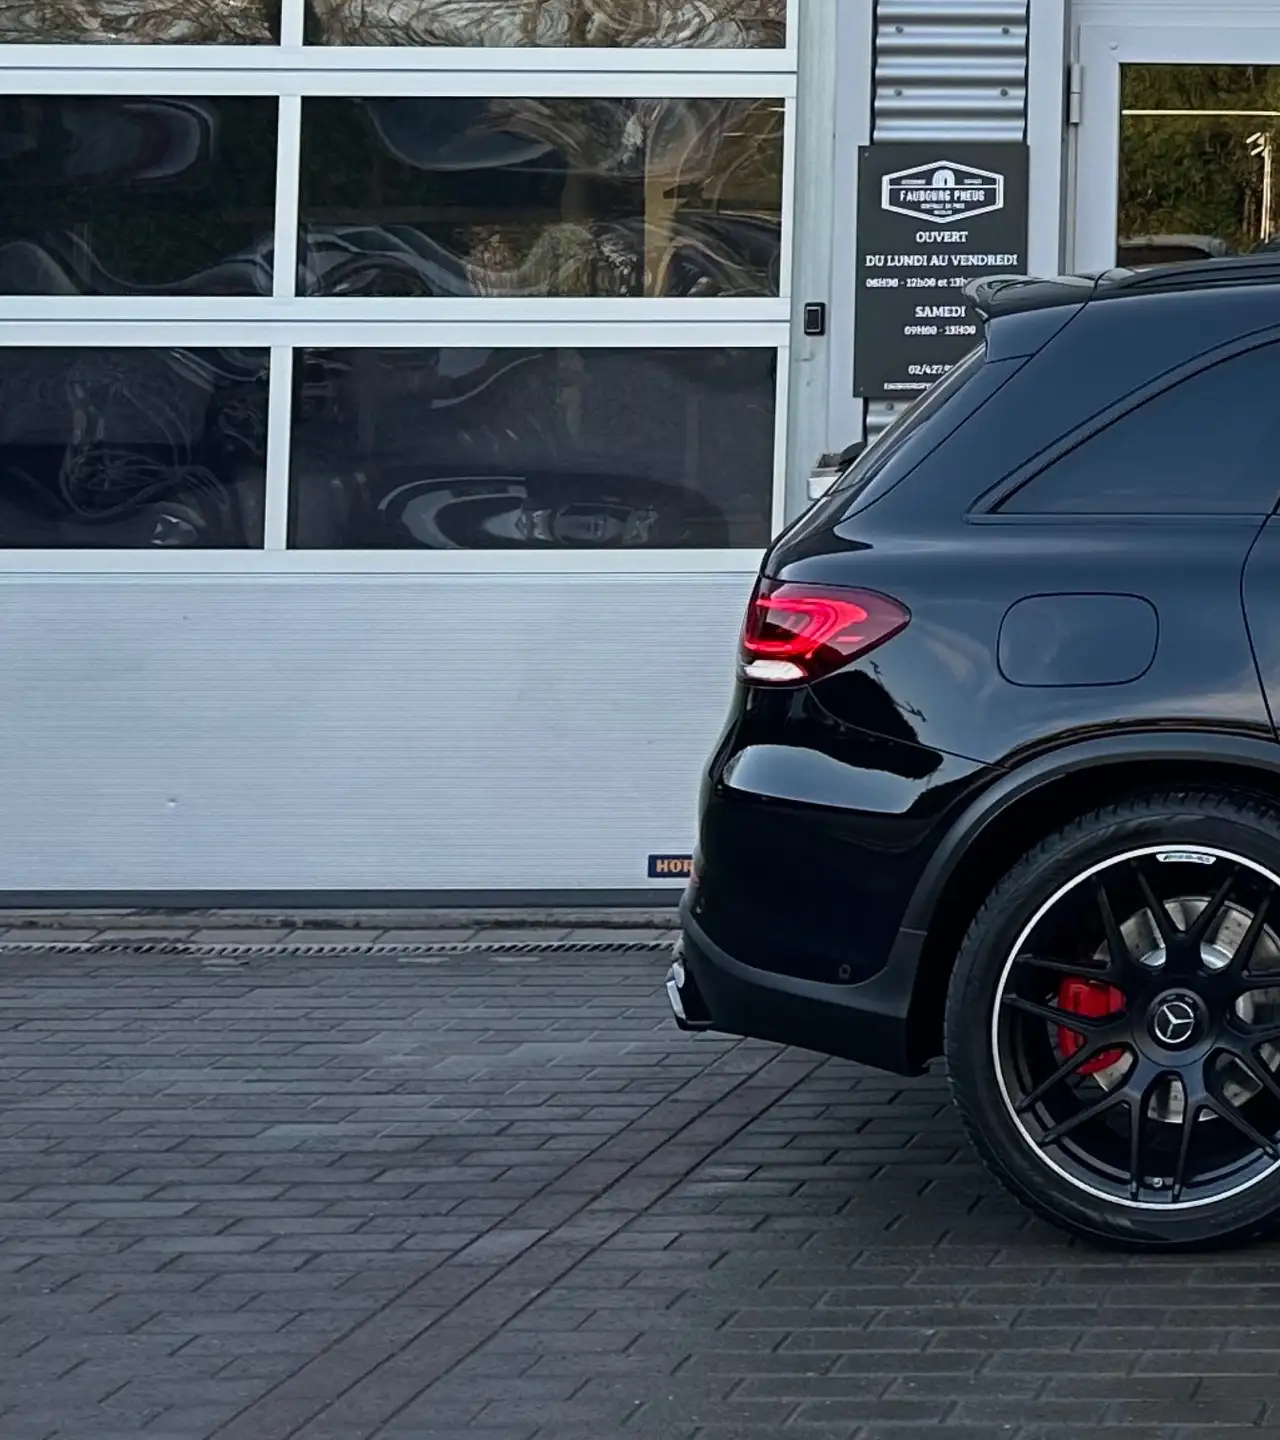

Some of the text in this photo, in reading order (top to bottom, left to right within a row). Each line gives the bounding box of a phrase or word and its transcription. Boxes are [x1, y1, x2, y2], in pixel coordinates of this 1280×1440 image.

[954, 190, 985, 201] PNEUS
[915, 231, 968, 243] OUVERT
[865, 254, 1018, 266] DU LUNDI AU VENDREDI
[937, 278, 948, 287] et
[915, 306, 966, 317] SAMEDI
